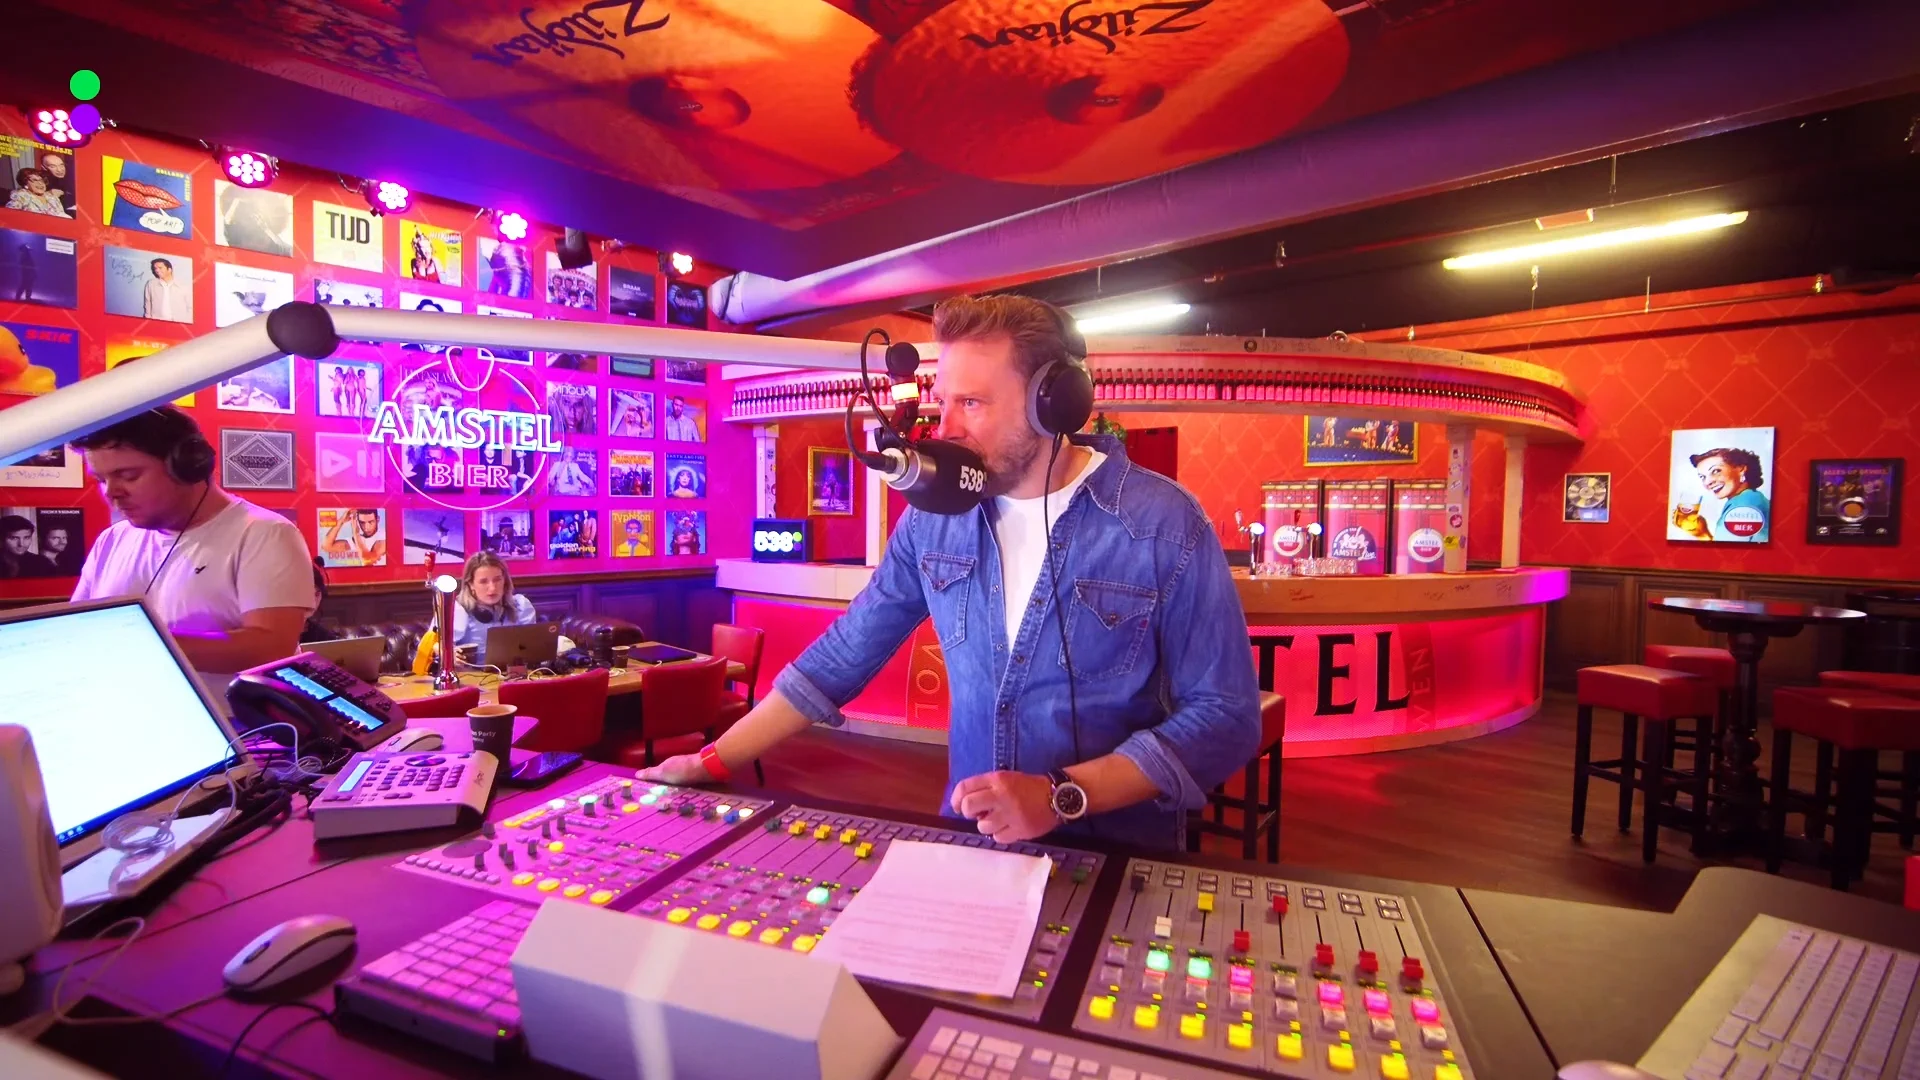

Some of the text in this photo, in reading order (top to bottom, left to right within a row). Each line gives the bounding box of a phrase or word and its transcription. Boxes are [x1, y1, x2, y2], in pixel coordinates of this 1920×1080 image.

[471, 0, 671, 68] Zildjian
[959, 0, 1214, 55] Zildjian
[325, 211, 370, 245] TIJD
[368, 401, 562, 453] AMSTEL
[428, 462, 511, 489] BIER
[959, 465, 984, 492] 538
[549, 542, 579, 550] golden
[754, 531, 793, 552] 538
